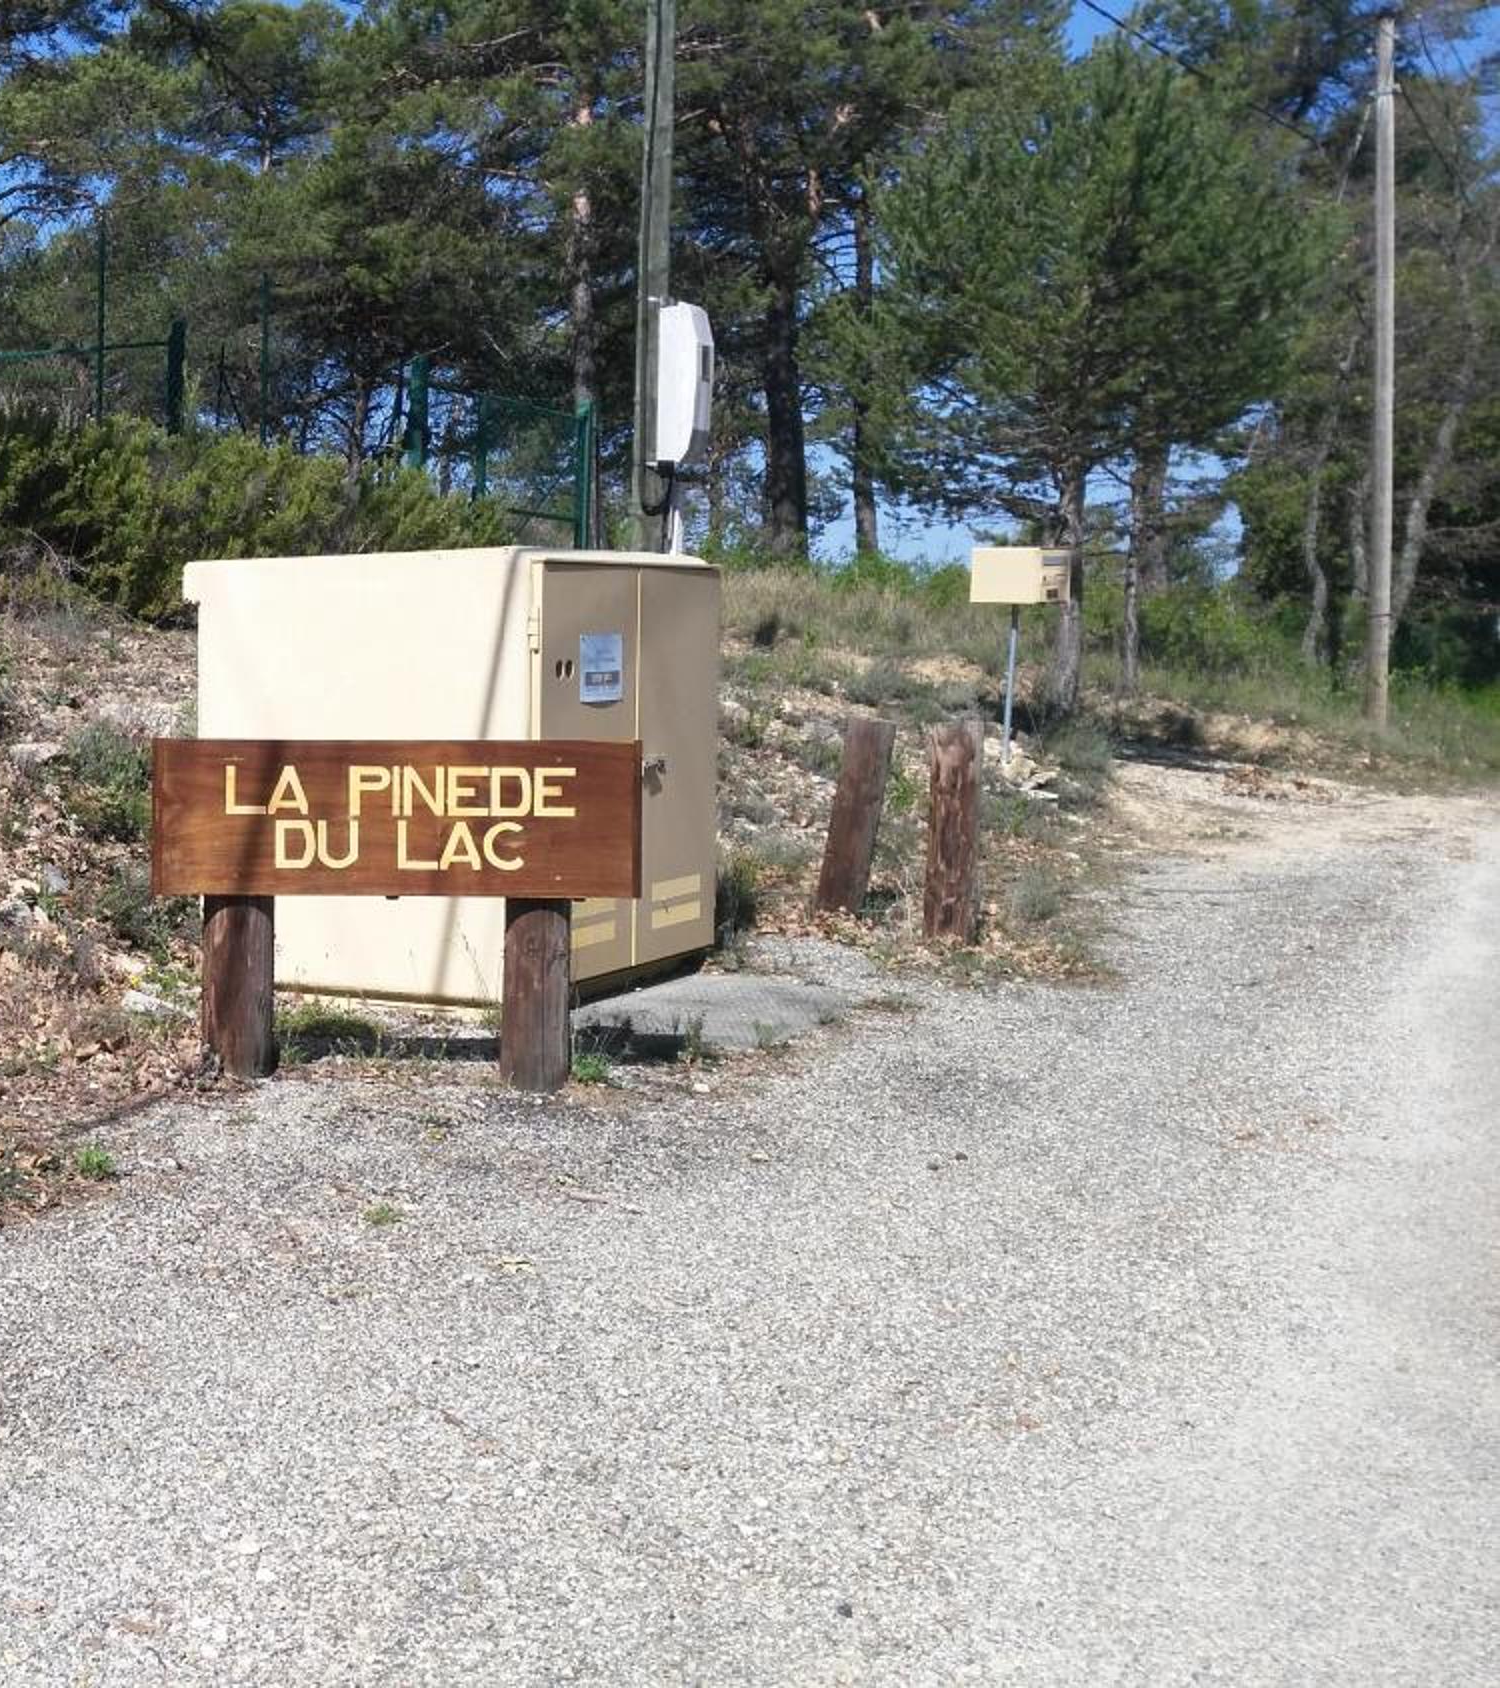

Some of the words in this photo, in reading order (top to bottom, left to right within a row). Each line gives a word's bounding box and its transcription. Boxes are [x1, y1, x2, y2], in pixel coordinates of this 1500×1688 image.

[224, 764, 309, 816] LA
[347, 765, 577, 818] PINEDE
[274, 819, 359, 869] DU
[397, 820, 525, 871] LAC
